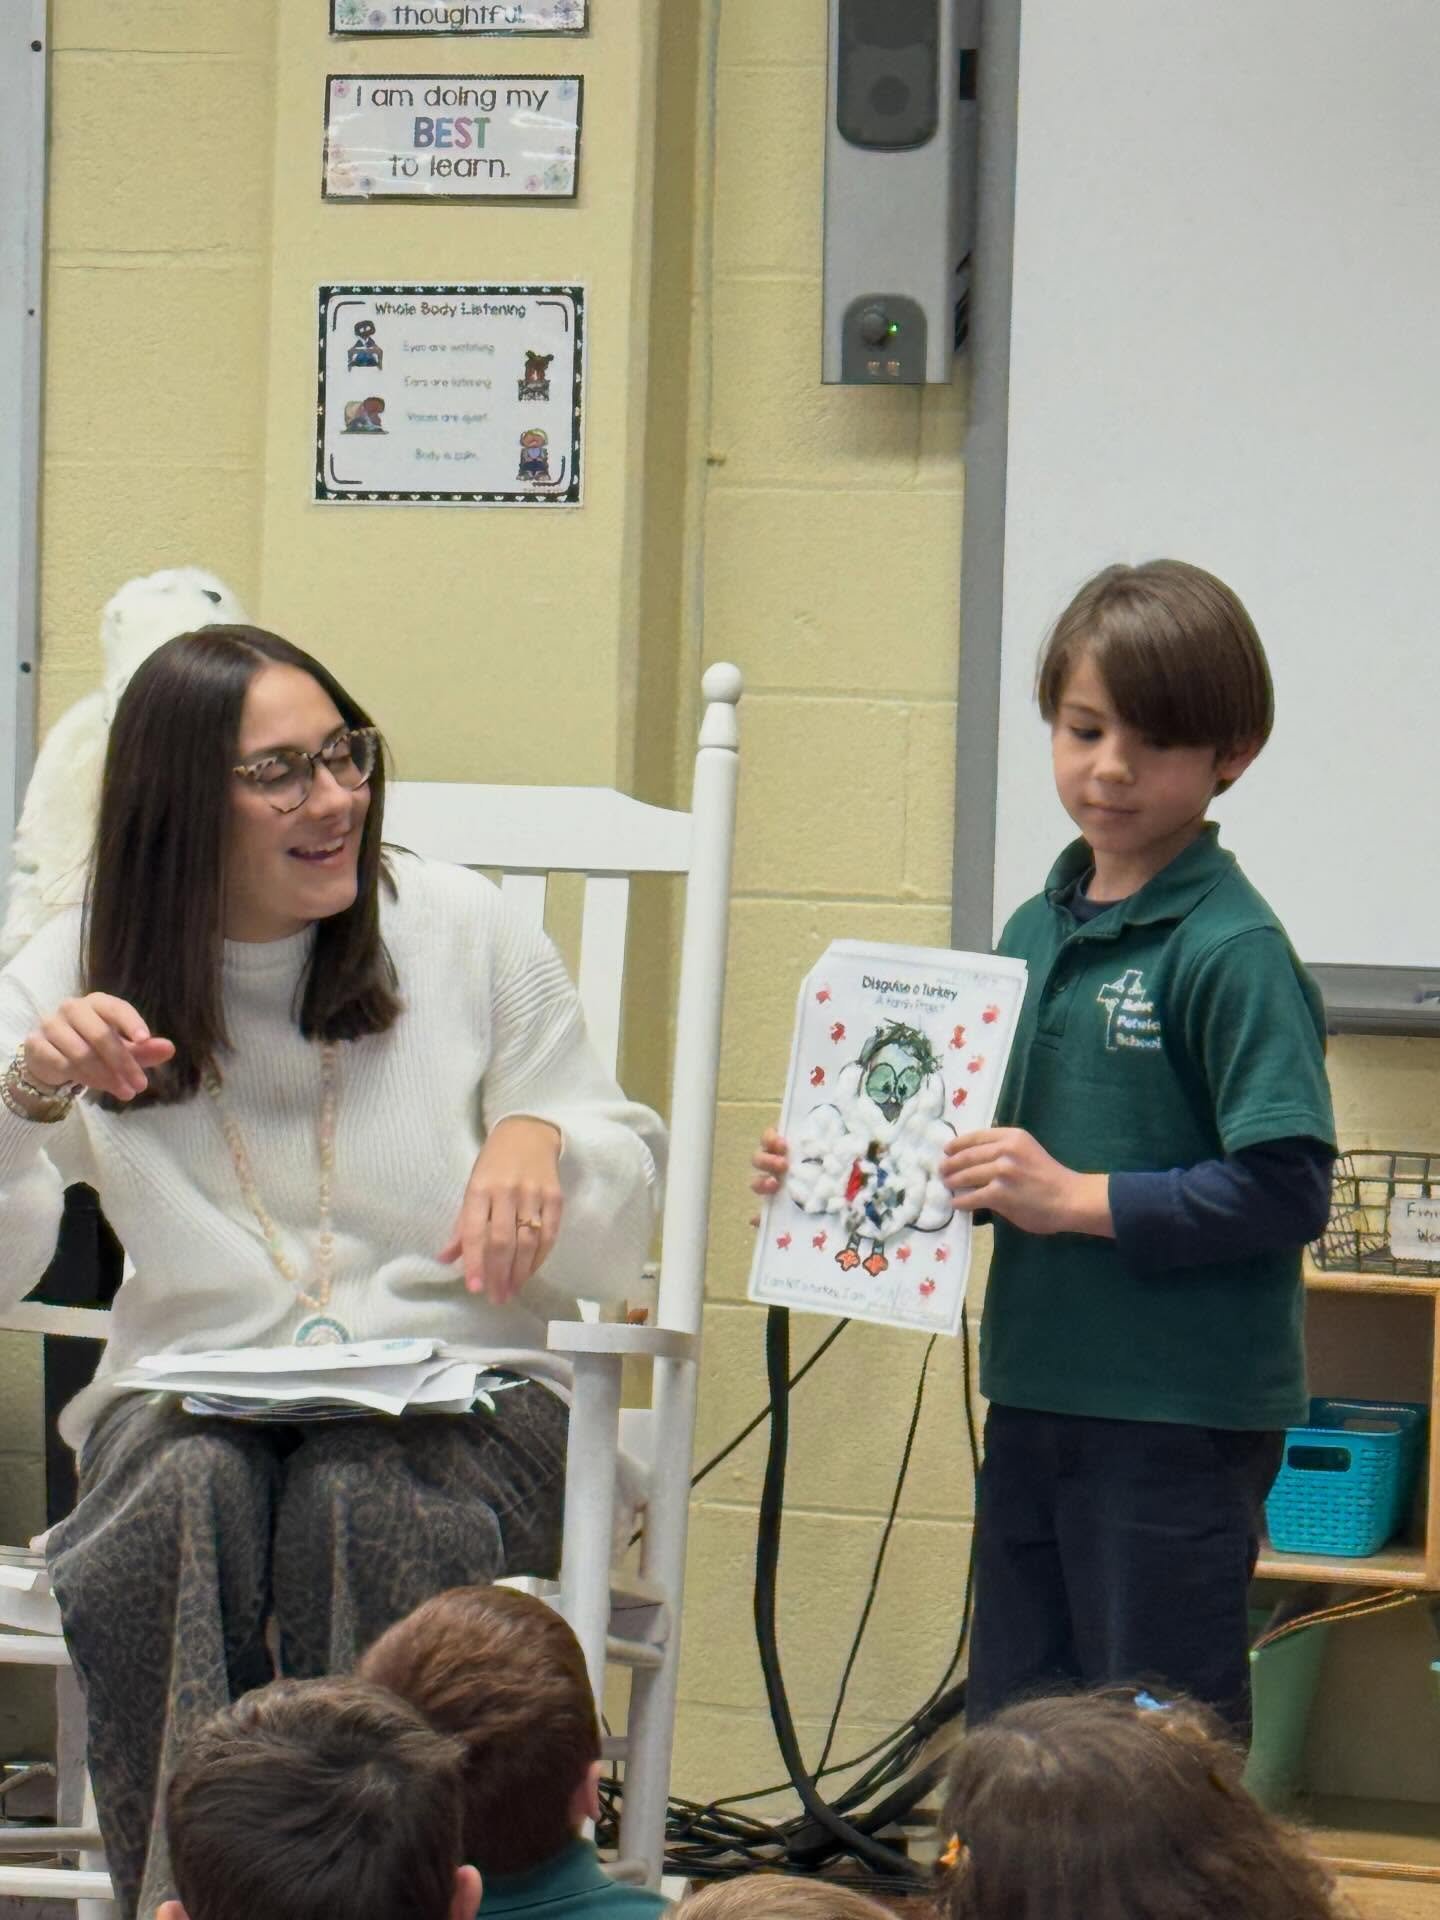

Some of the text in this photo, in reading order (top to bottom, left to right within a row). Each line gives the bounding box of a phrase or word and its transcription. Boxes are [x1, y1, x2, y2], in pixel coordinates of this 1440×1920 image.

[356, 86, 549, 111] I am doing my
[413, 117, 491, 149] BEST
[389, 154, 510, 178] to learn.
[375, 301, 526, 318] Whole Body Listening
[862, 975, 911, 994] Disguise
[922, 983, 958, 1001] Turkey
